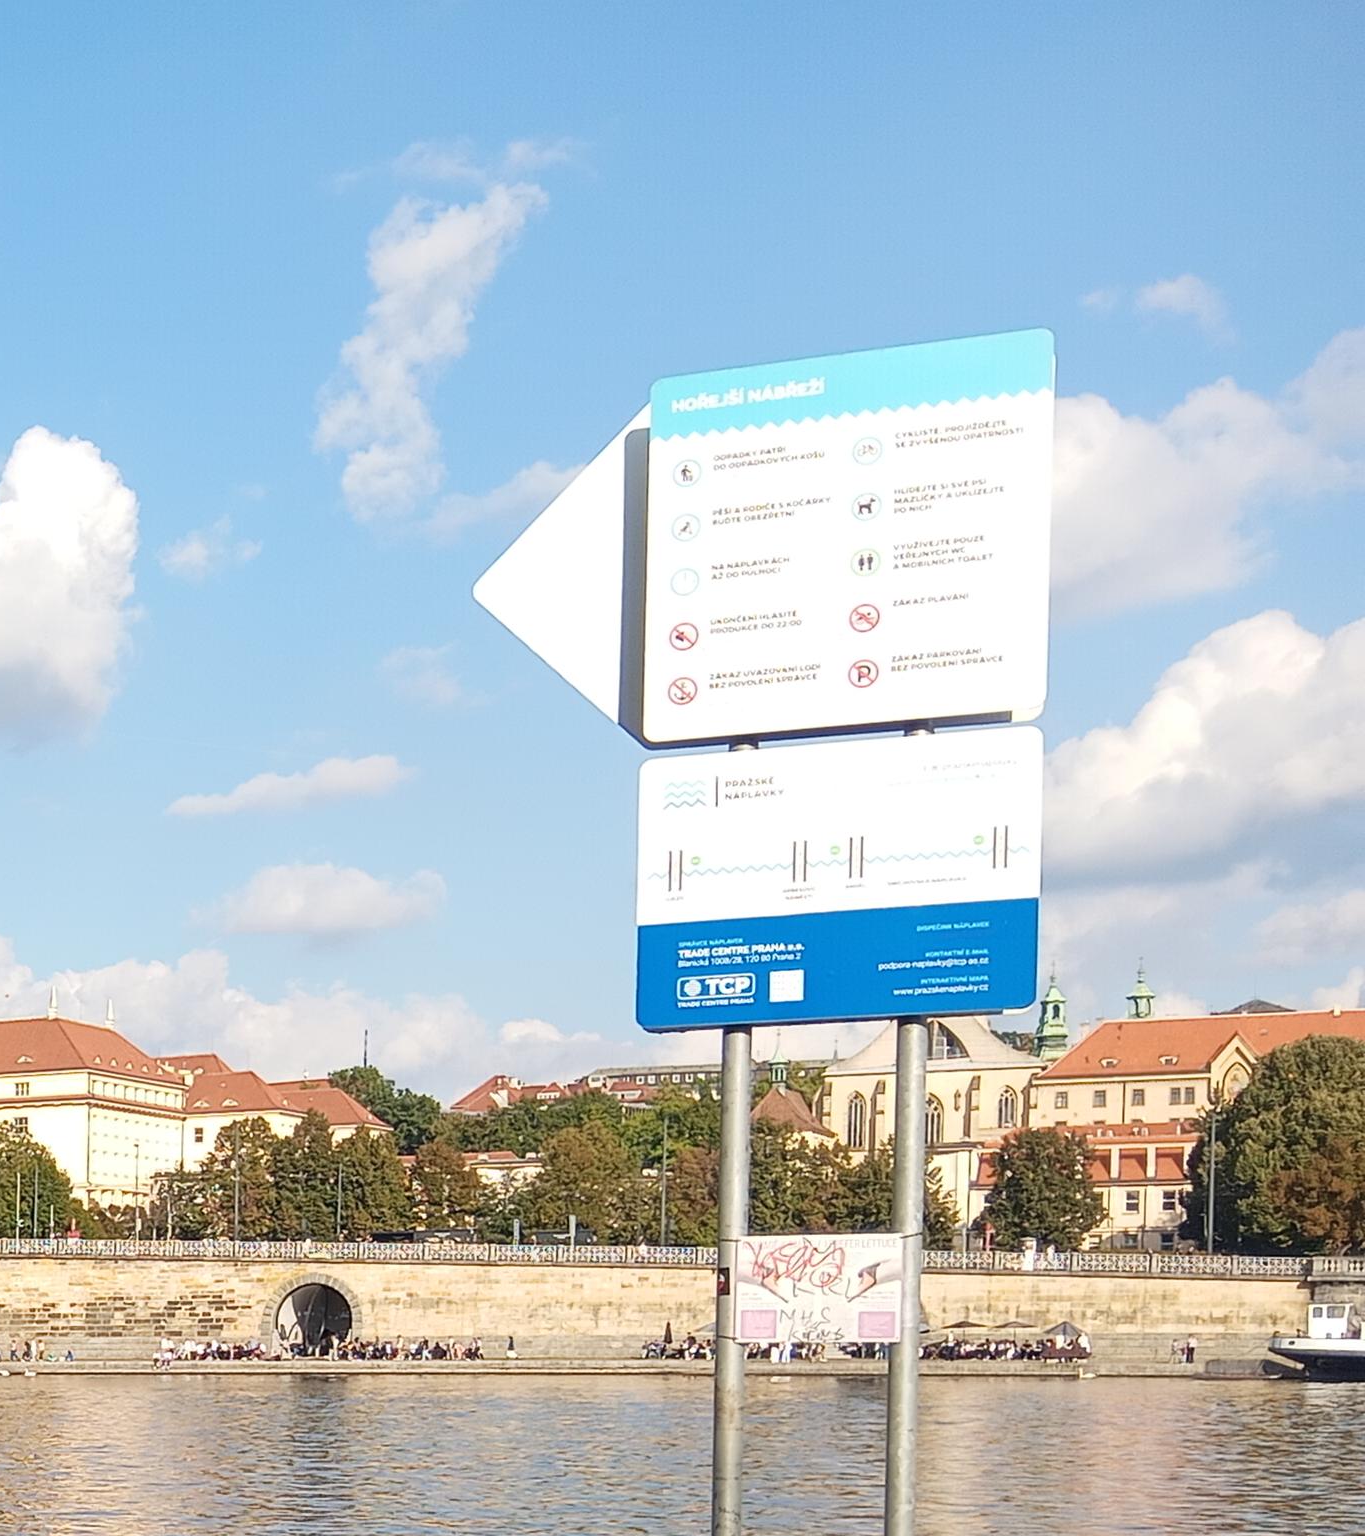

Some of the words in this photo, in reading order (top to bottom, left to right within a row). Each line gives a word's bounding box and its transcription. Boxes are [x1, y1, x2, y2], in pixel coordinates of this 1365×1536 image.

[671, 387, 745, 414] HOŘEJŠÍ
[748, 377, 826, 403] NÁBŘEŽÍ
[678, 948, 710, 959] TRADE
[711, 945, 750, 956] CENTRE
[705, 977, 751, 996] TCP
